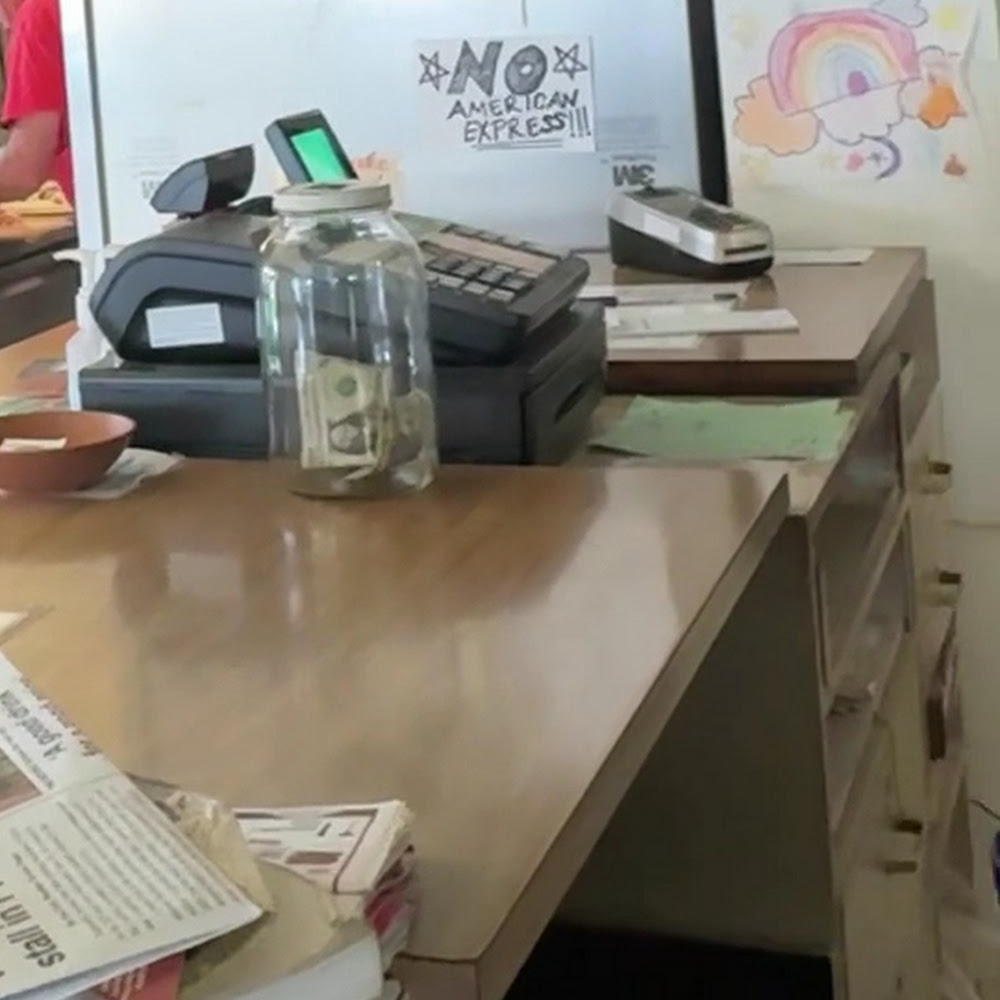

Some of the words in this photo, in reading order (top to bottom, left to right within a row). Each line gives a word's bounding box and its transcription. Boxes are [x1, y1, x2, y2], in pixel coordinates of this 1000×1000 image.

[447, 40, 548, 97] NO
[447, 89, 579, 120] AMERICAN
[463, 106, 592, 144] EXPRESS!!!
[612, 164, 656, 187] 3M
[6, 925, 66, 969] stall
